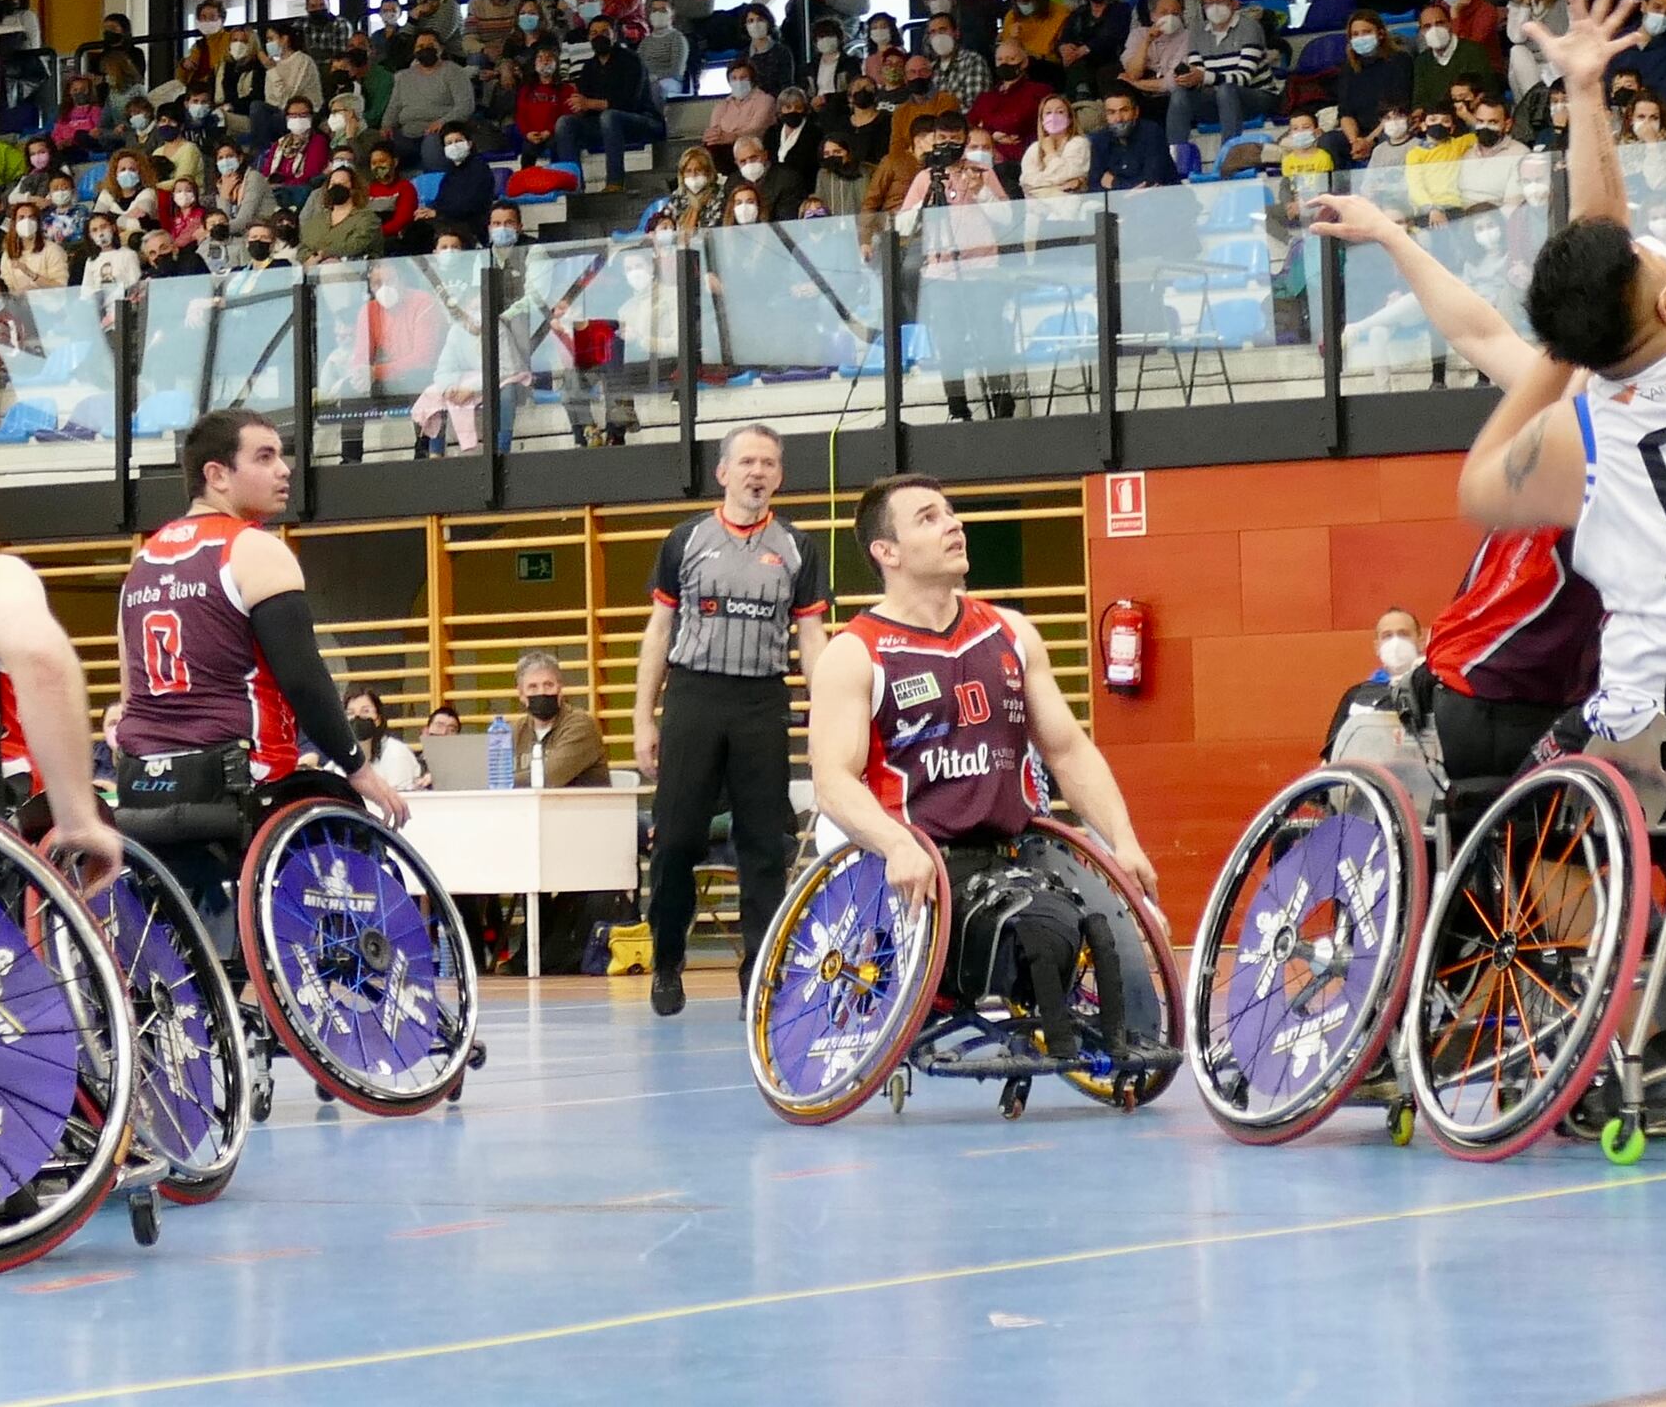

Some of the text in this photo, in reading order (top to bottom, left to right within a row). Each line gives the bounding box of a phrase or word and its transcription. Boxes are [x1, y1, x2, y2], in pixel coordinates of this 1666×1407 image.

[143, 610, 191, 696] 0
[954, 681, 991, 728] 10
[920, 743, 989, 782] Vital
[132, 780, 178, 792] ELITE
